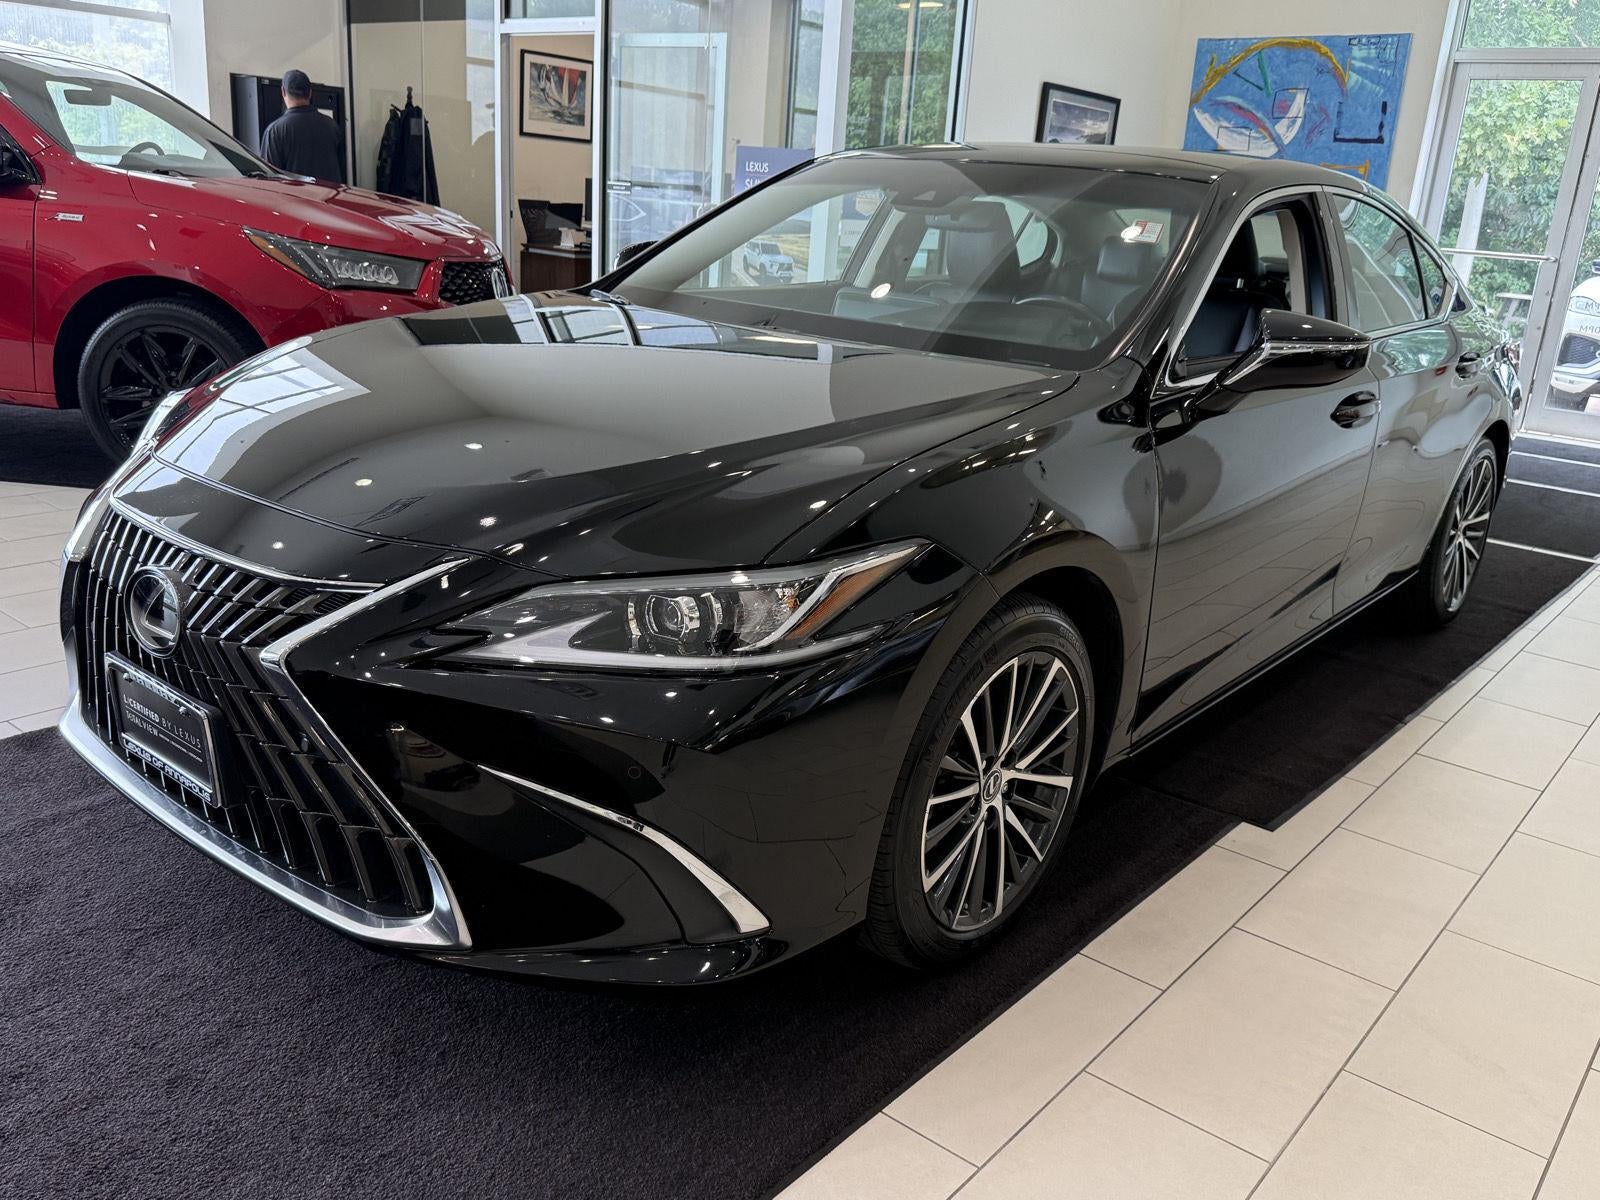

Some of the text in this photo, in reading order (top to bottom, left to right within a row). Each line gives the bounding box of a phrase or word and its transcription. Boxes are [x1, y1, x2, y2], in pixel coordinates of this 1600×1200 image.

[745, 161, 769, 173] LEXUS
[161, 717, 172, 730] BY
[174, 726, 202, 748] LEXUS
[123, 738, 152, 762] LEXUS
[152, 757, 164, 769] OF
